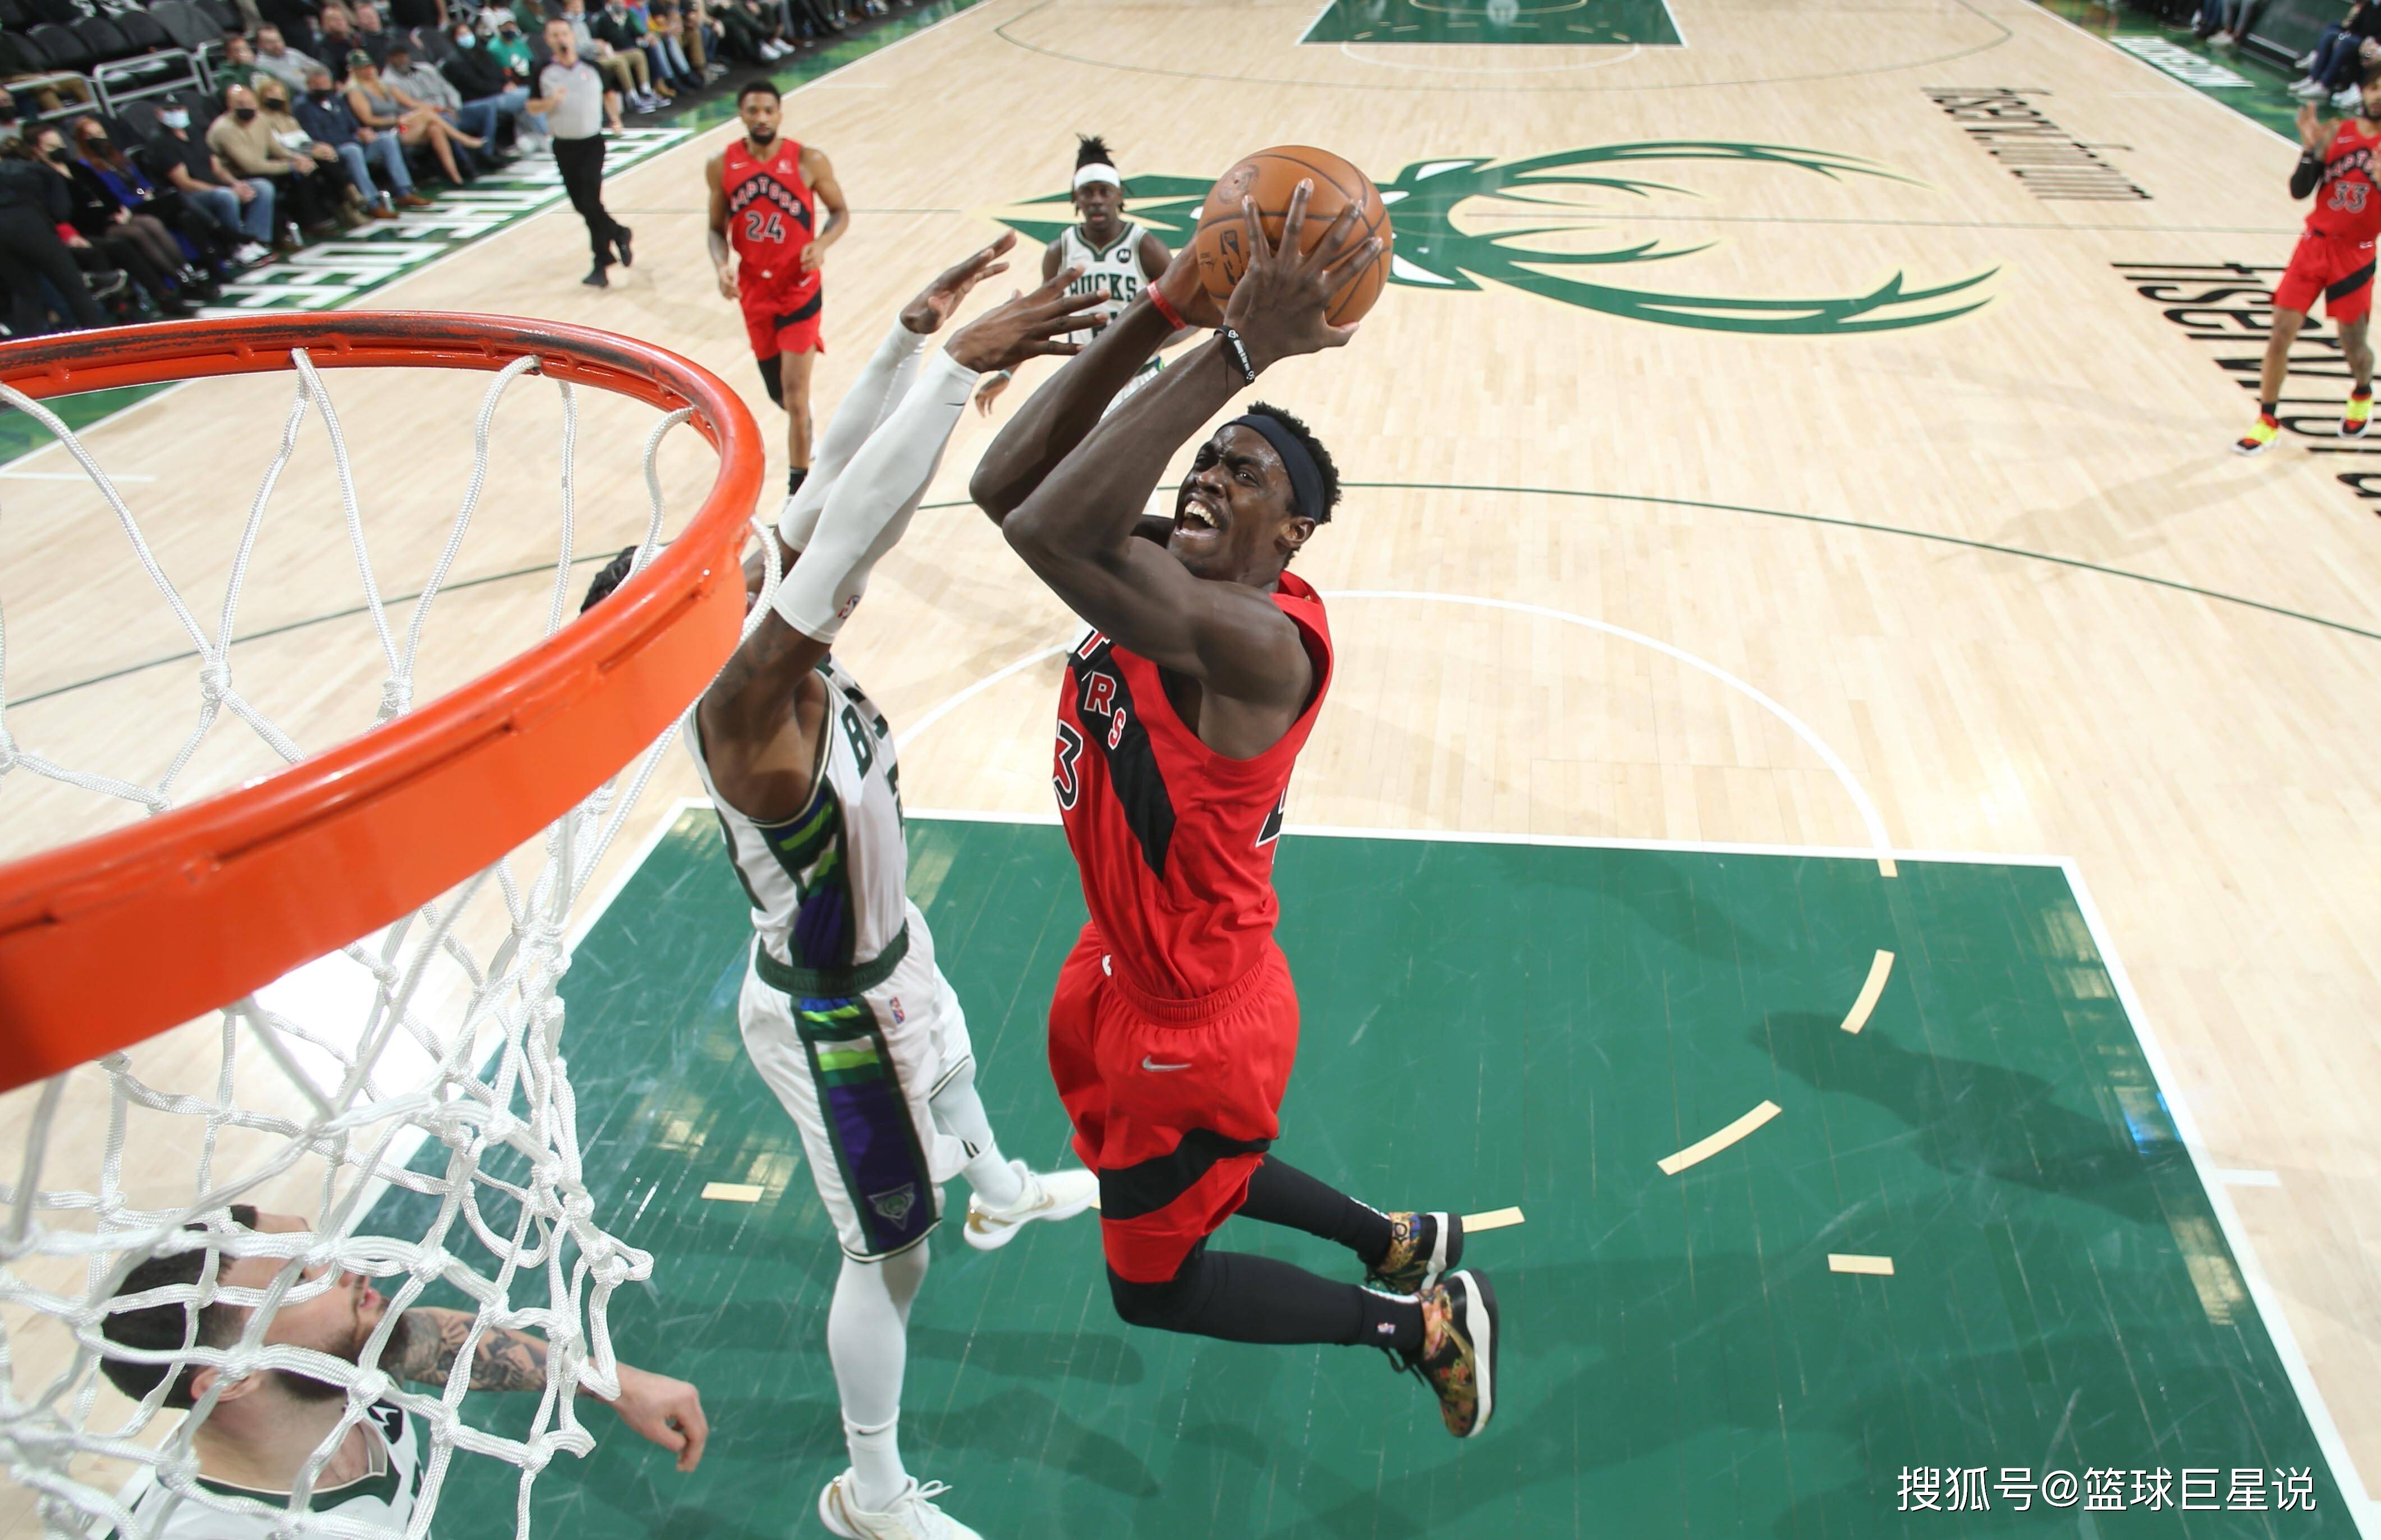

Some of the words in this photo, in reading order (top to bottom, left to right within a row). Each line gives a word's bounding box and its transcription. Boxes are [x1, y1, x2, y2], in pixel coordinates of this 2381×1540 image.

[2327, 180, 2370, 214] 33
[745, 210, 786, 244] 24
[196, 242, 448, 319] DEE
